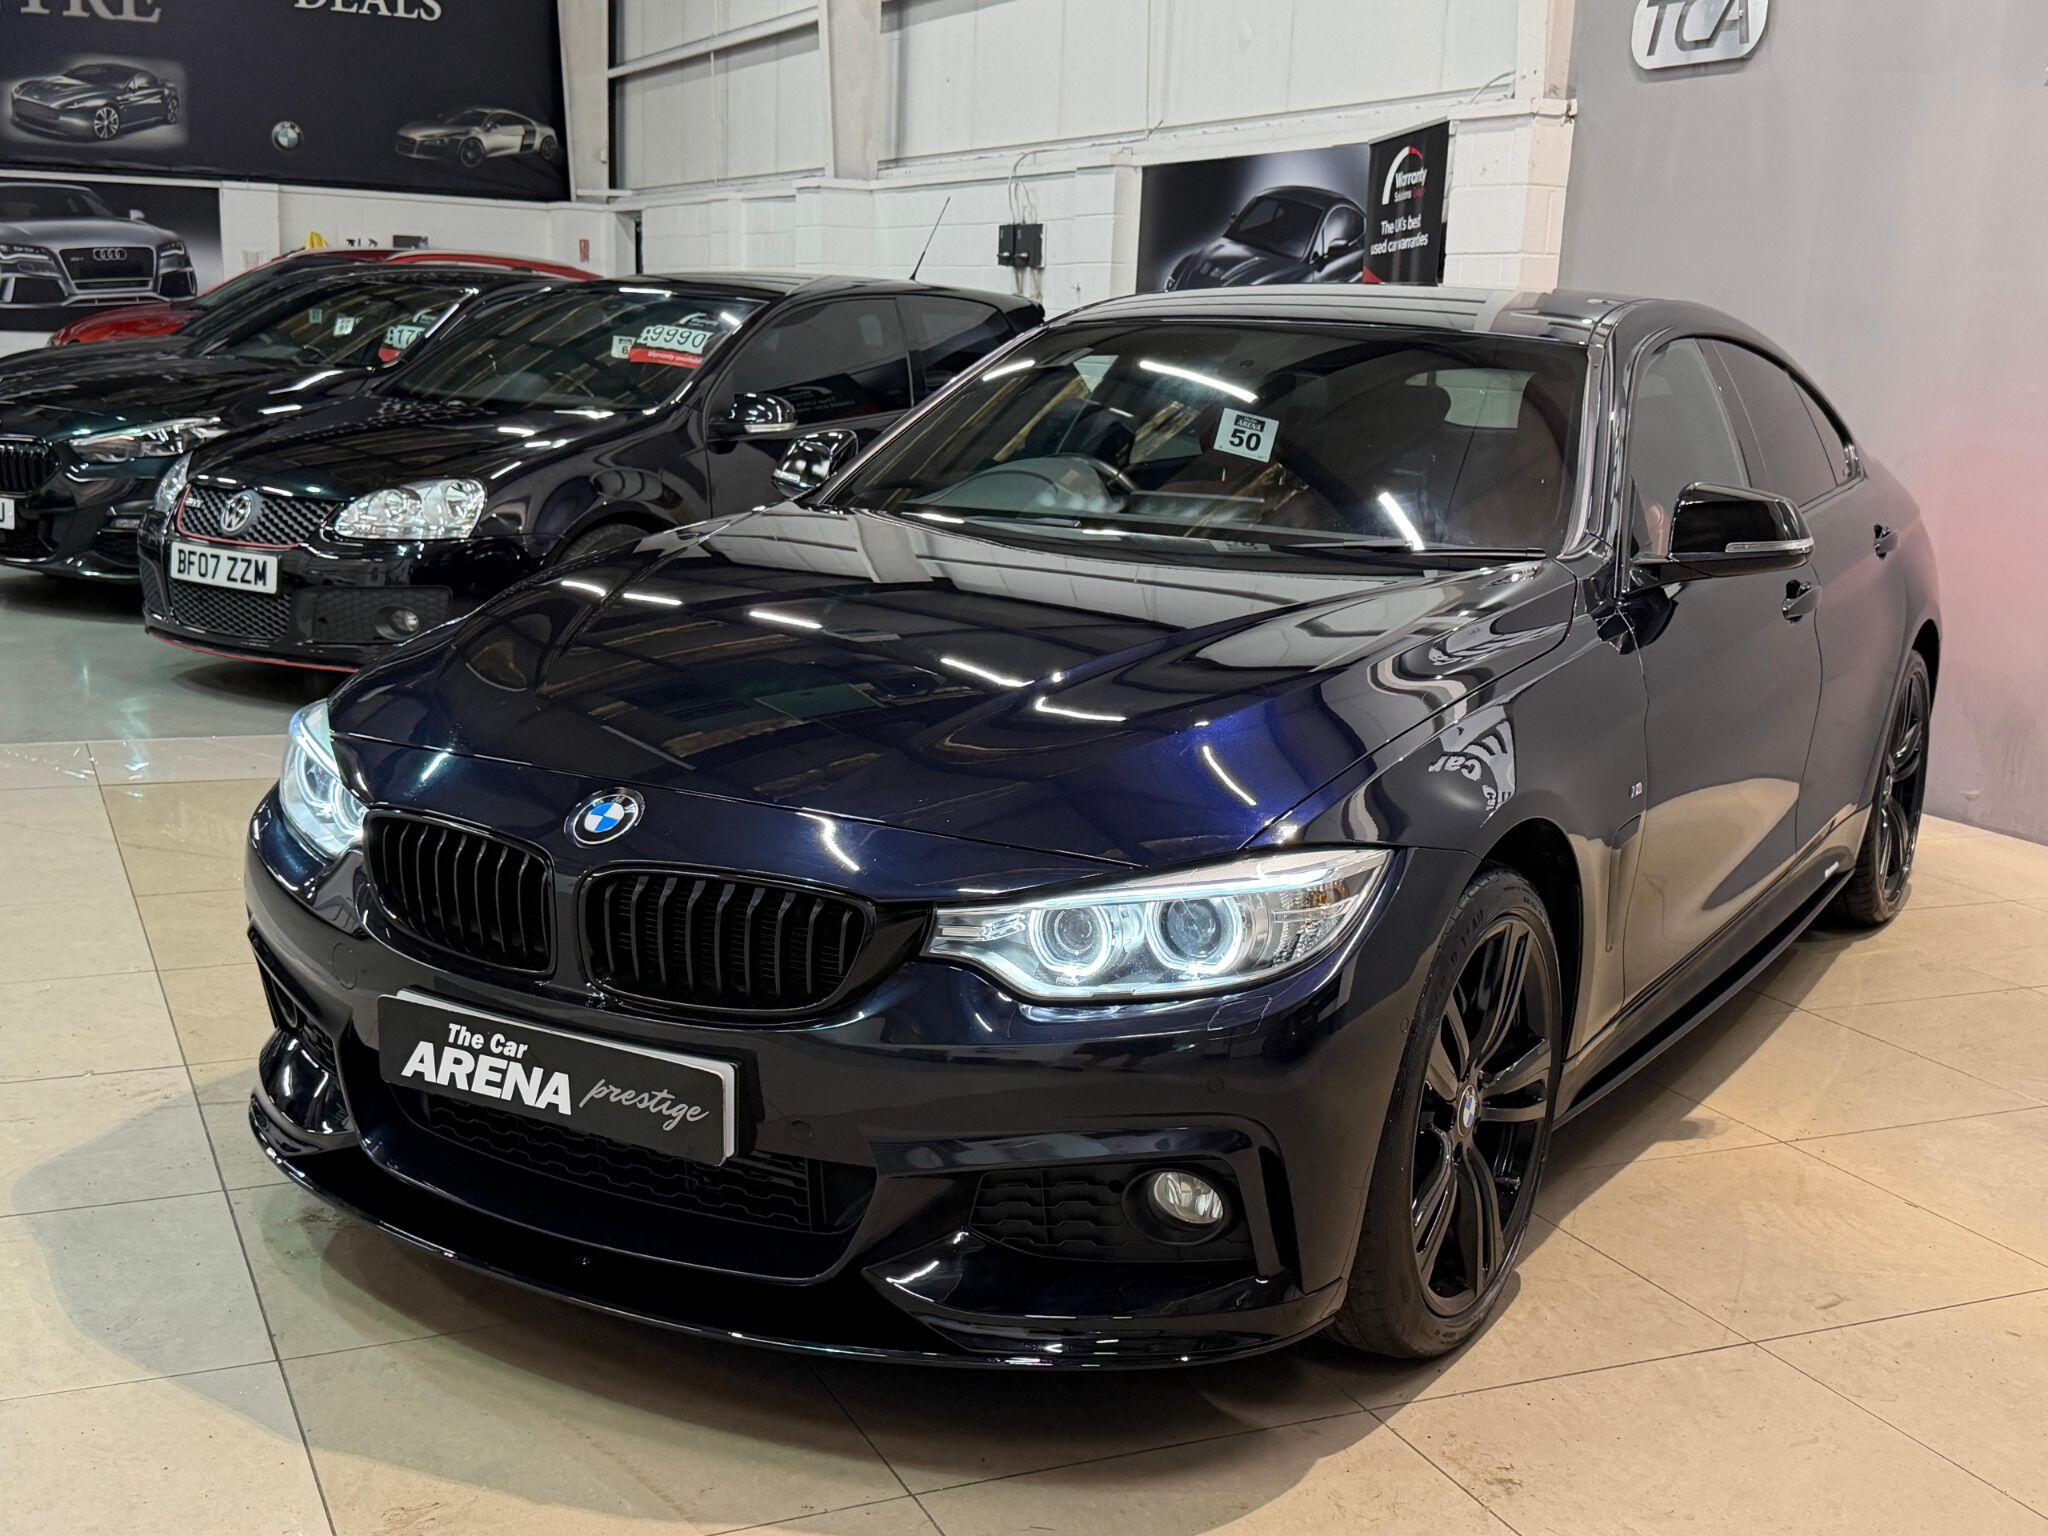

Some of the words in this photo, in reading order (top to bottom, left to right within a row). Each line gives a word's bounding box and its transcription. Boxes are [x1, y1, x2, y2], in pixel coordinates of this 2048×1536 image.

[1646, 0, 1750, 57] TCA
[1395, 167, 1427, 189] Warranty
[1381, 219, 1395, 236] The
[1370, 238, 1388, 256] used
[1229, 428, 1262, 452] 50
[177, 549, 221, 580] BF07
[226, 555, 268, 587] ZZM
[448, 1023, 483, 1050] The
[489, 1032, 529, 1060] Car
[400, 1040, 573, 1116] ARENA
[579, 1078, 710, 1132] prestige
